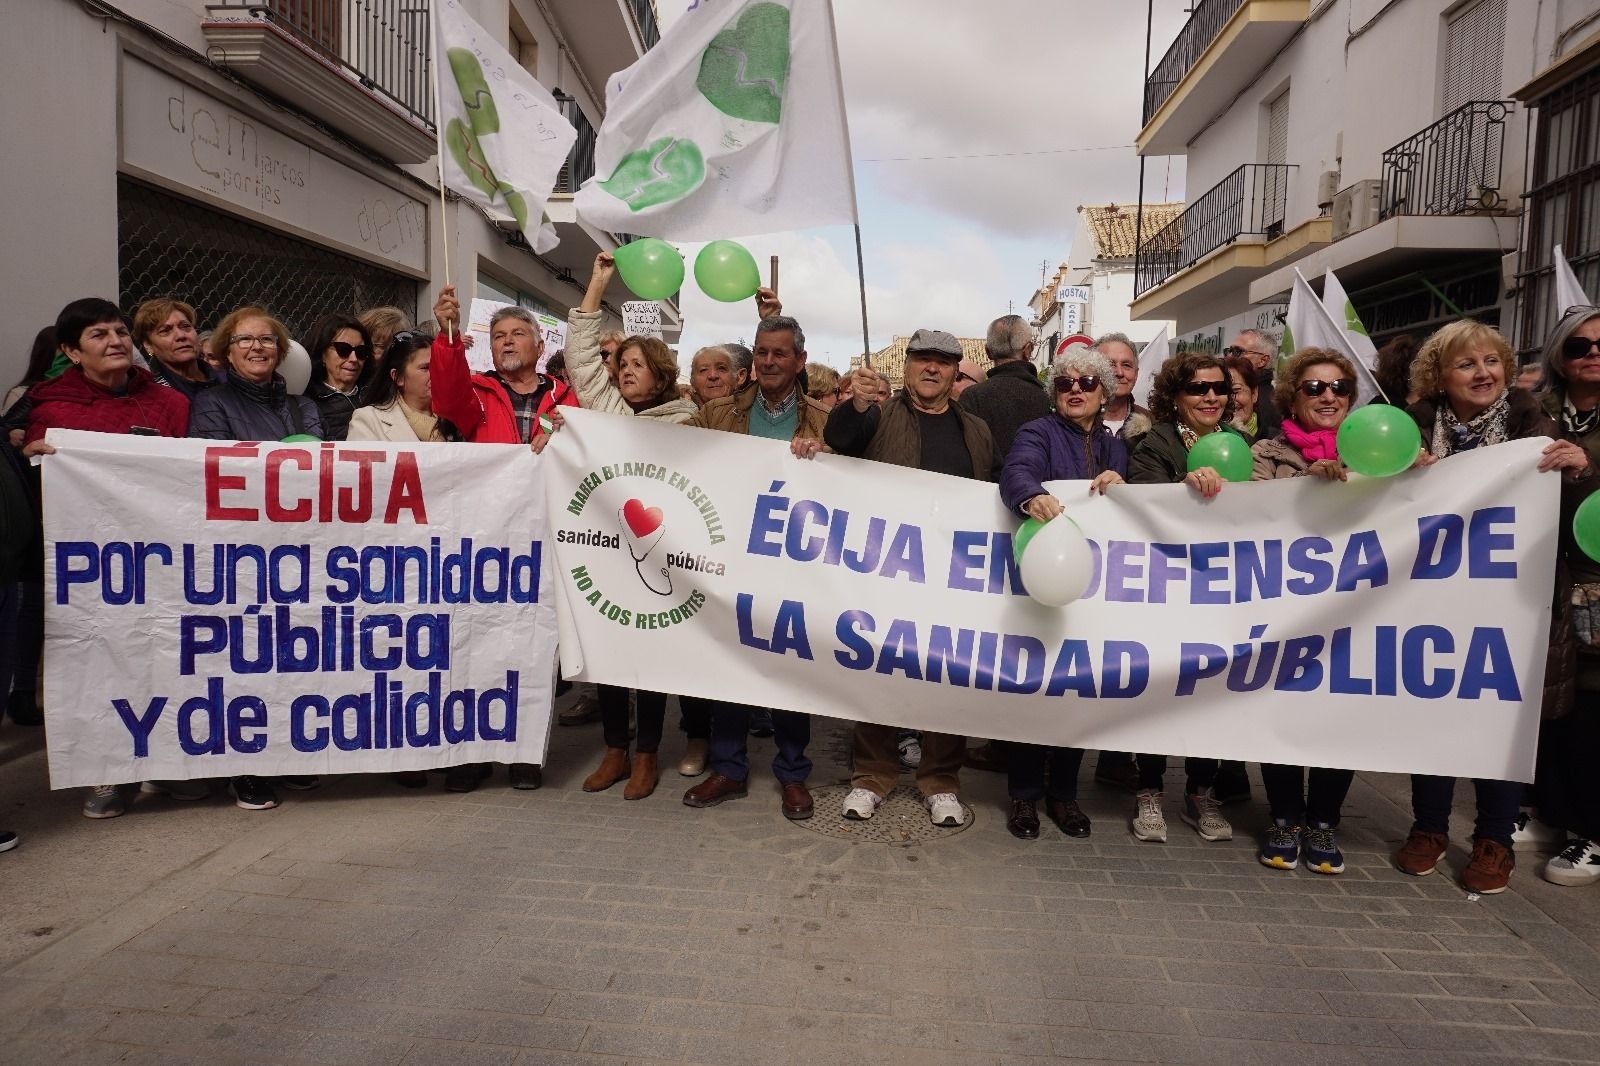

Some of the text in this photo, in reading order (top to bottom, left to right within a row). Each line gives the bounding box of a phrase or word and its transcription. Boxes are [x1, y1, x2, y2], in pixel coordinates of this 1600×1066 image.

[1059, 287, 1088, 301] HOSTAL
[566, 462, 726, 546] MAREA BLANCA EN SEVILLA
[746, 480, 926, 584] ÉCIJA
[1410, 506, 1518, 579] DE
[55, 536, 542, 605] Por una sanidad
[556, 529, 726, 576] sanidad pública
[570, 565, 706, 630] NO A LOS RECORTES
[736, 592, 1523, 702] LA SANIDAD PÚBLICA
[111, 670, 519, 758] Y de calidad
